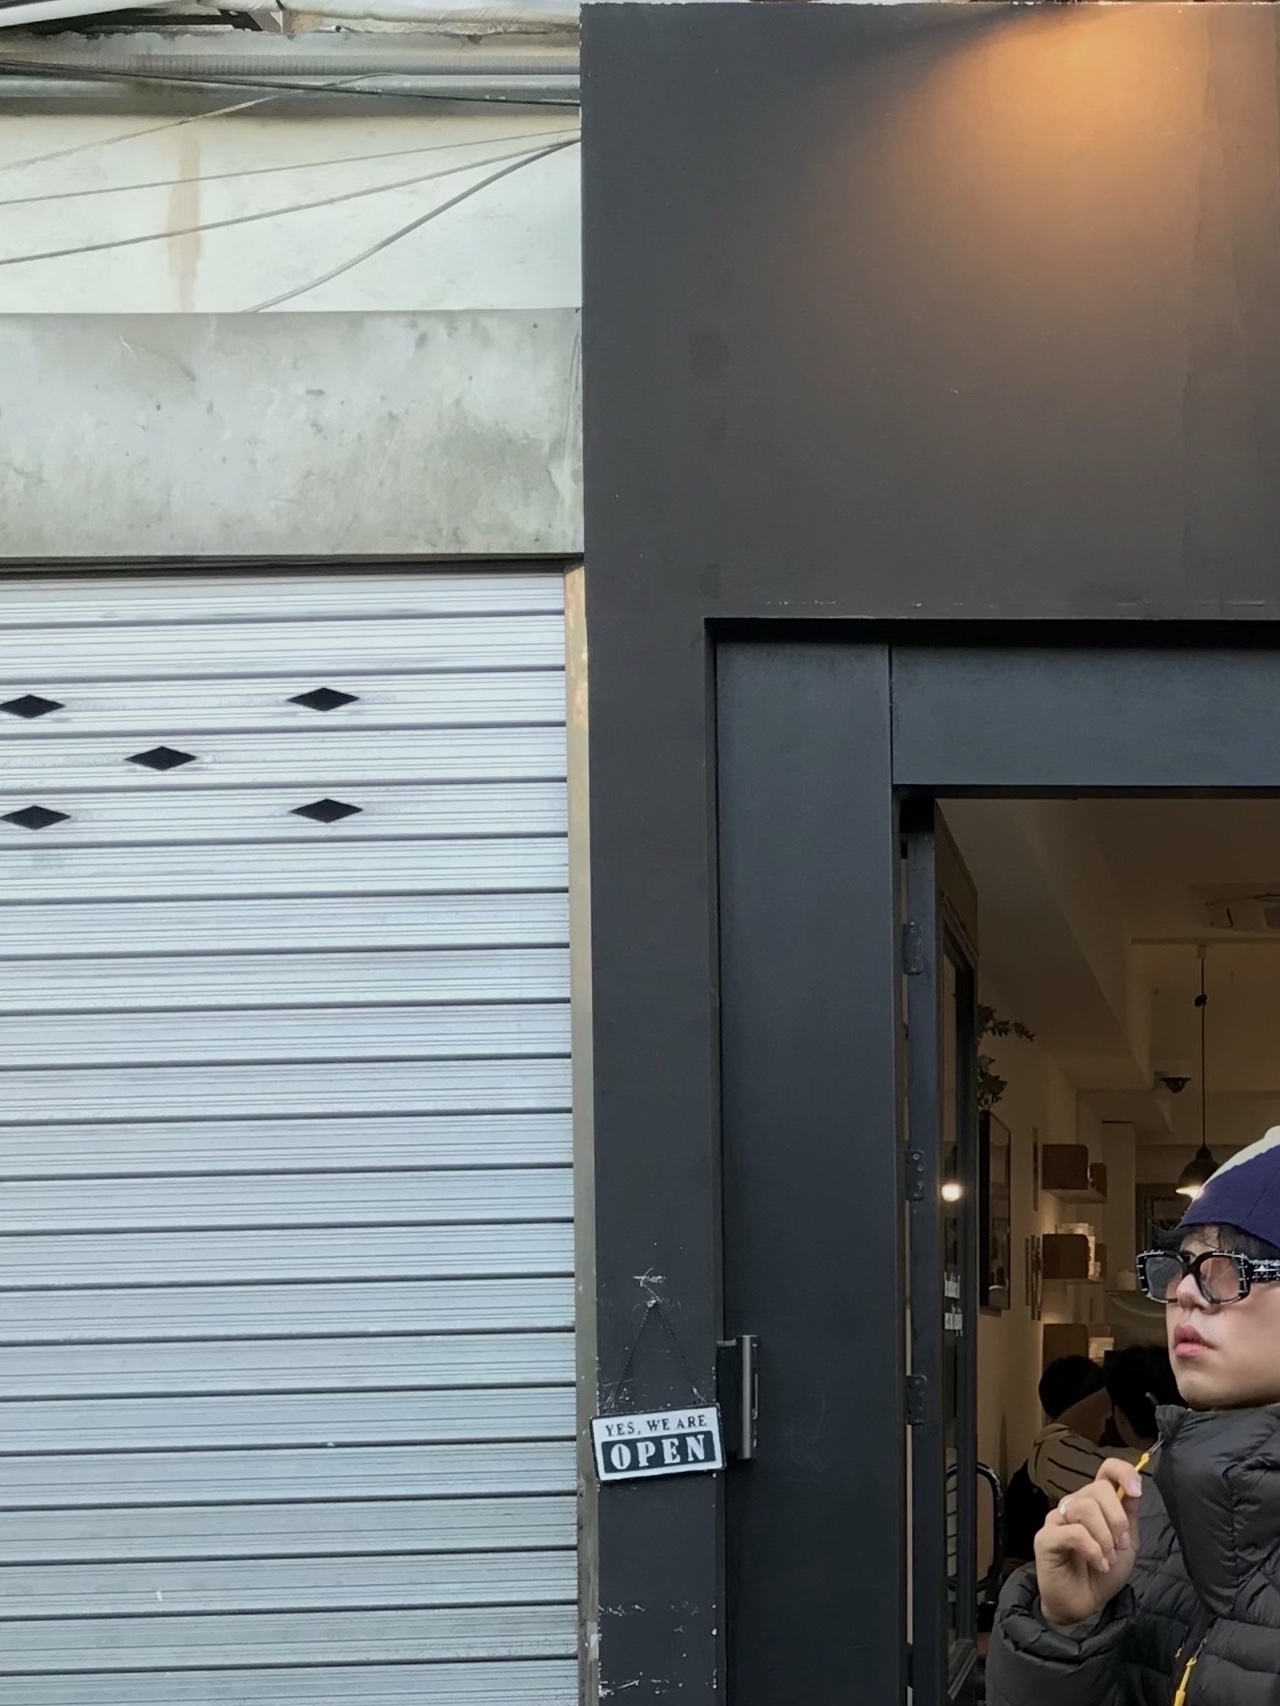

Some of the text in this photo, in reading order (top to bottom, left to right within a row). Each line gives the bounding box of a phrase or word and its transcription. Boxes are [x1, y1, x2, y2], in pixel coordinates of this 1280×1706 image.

[605, 1414, 707, 1436] YES, WE ARE
[610, 1434, 705, 1470] OPEN
